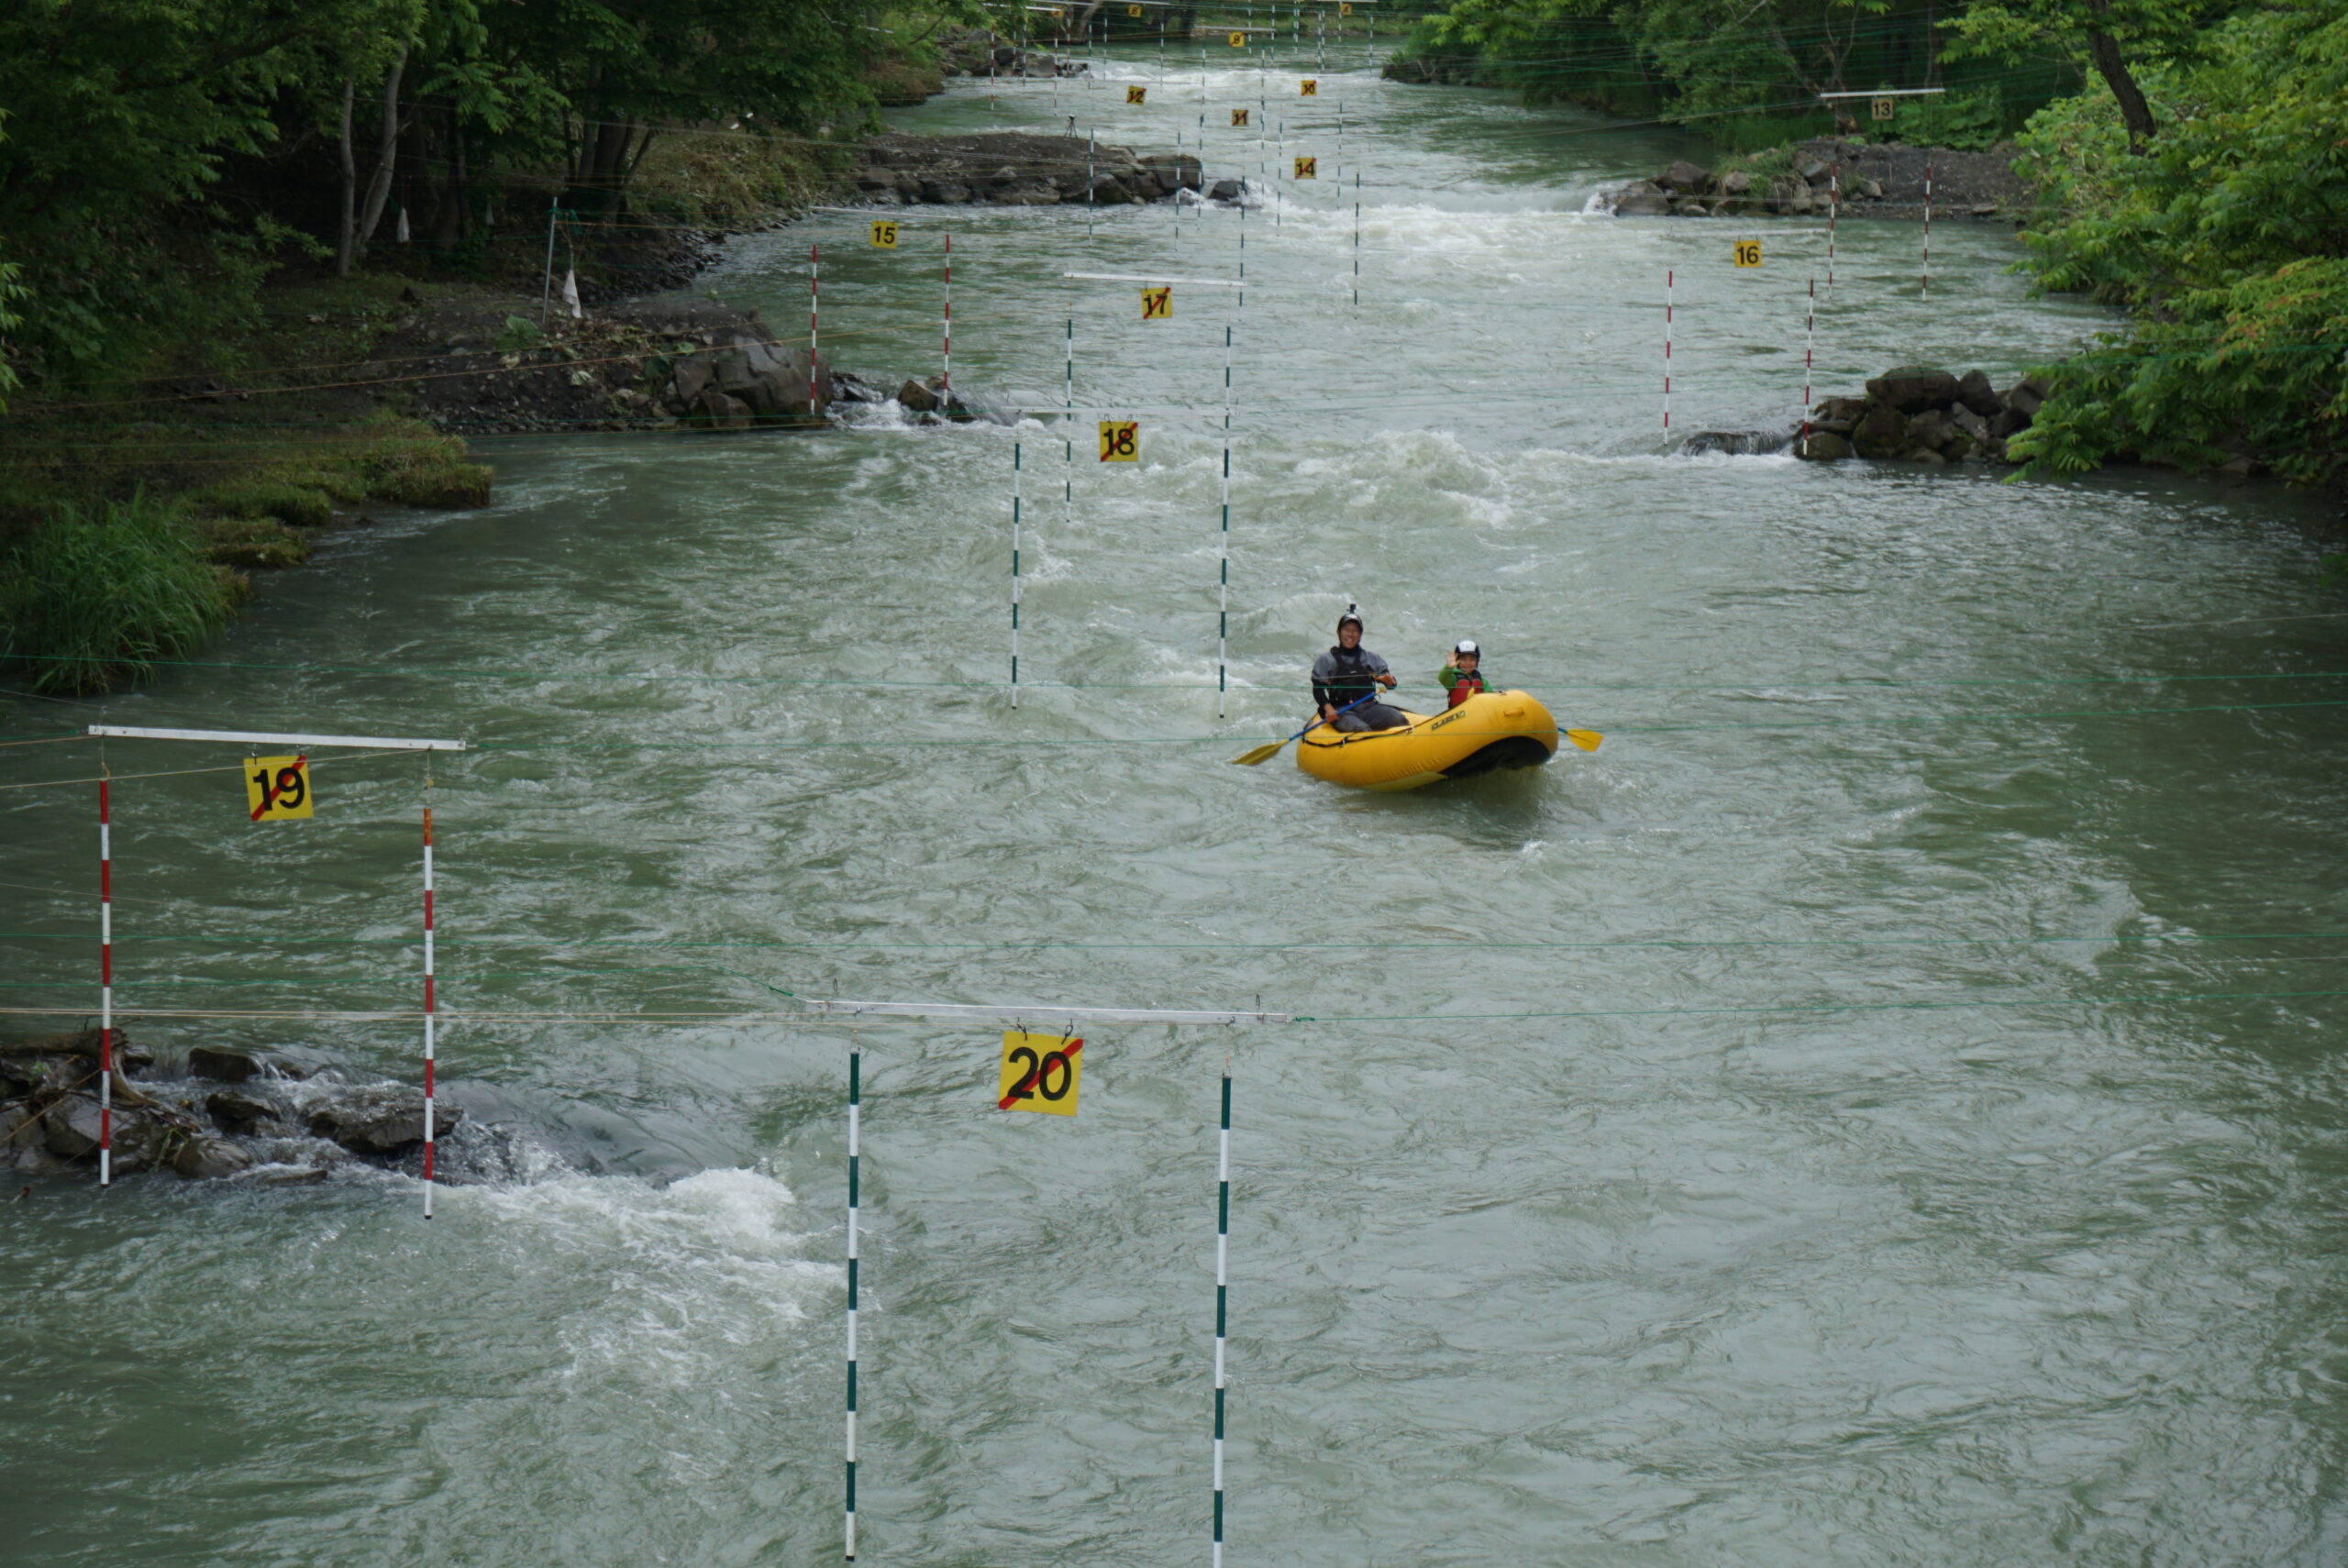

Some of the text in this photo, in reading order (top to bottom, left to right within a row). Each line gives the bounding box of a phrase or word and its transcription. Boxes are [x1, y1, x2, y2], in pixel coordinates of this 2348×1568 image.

[1129, 91, 1144, 103] 12
[1874, 103, 1890, 116] 13
[1234, 113, 1248, 125] 11
[1296, 162, 1314, 176] 14
[874, 226, 896, 244] 15
[1737, 246, 1759, 264] 16
[1144, 294, 1168, 315] 17
[1103, 428, 1135, 456] 18
[253, 767, 305, 812] 19
[1007, 1046, 1072, 1101] 20
